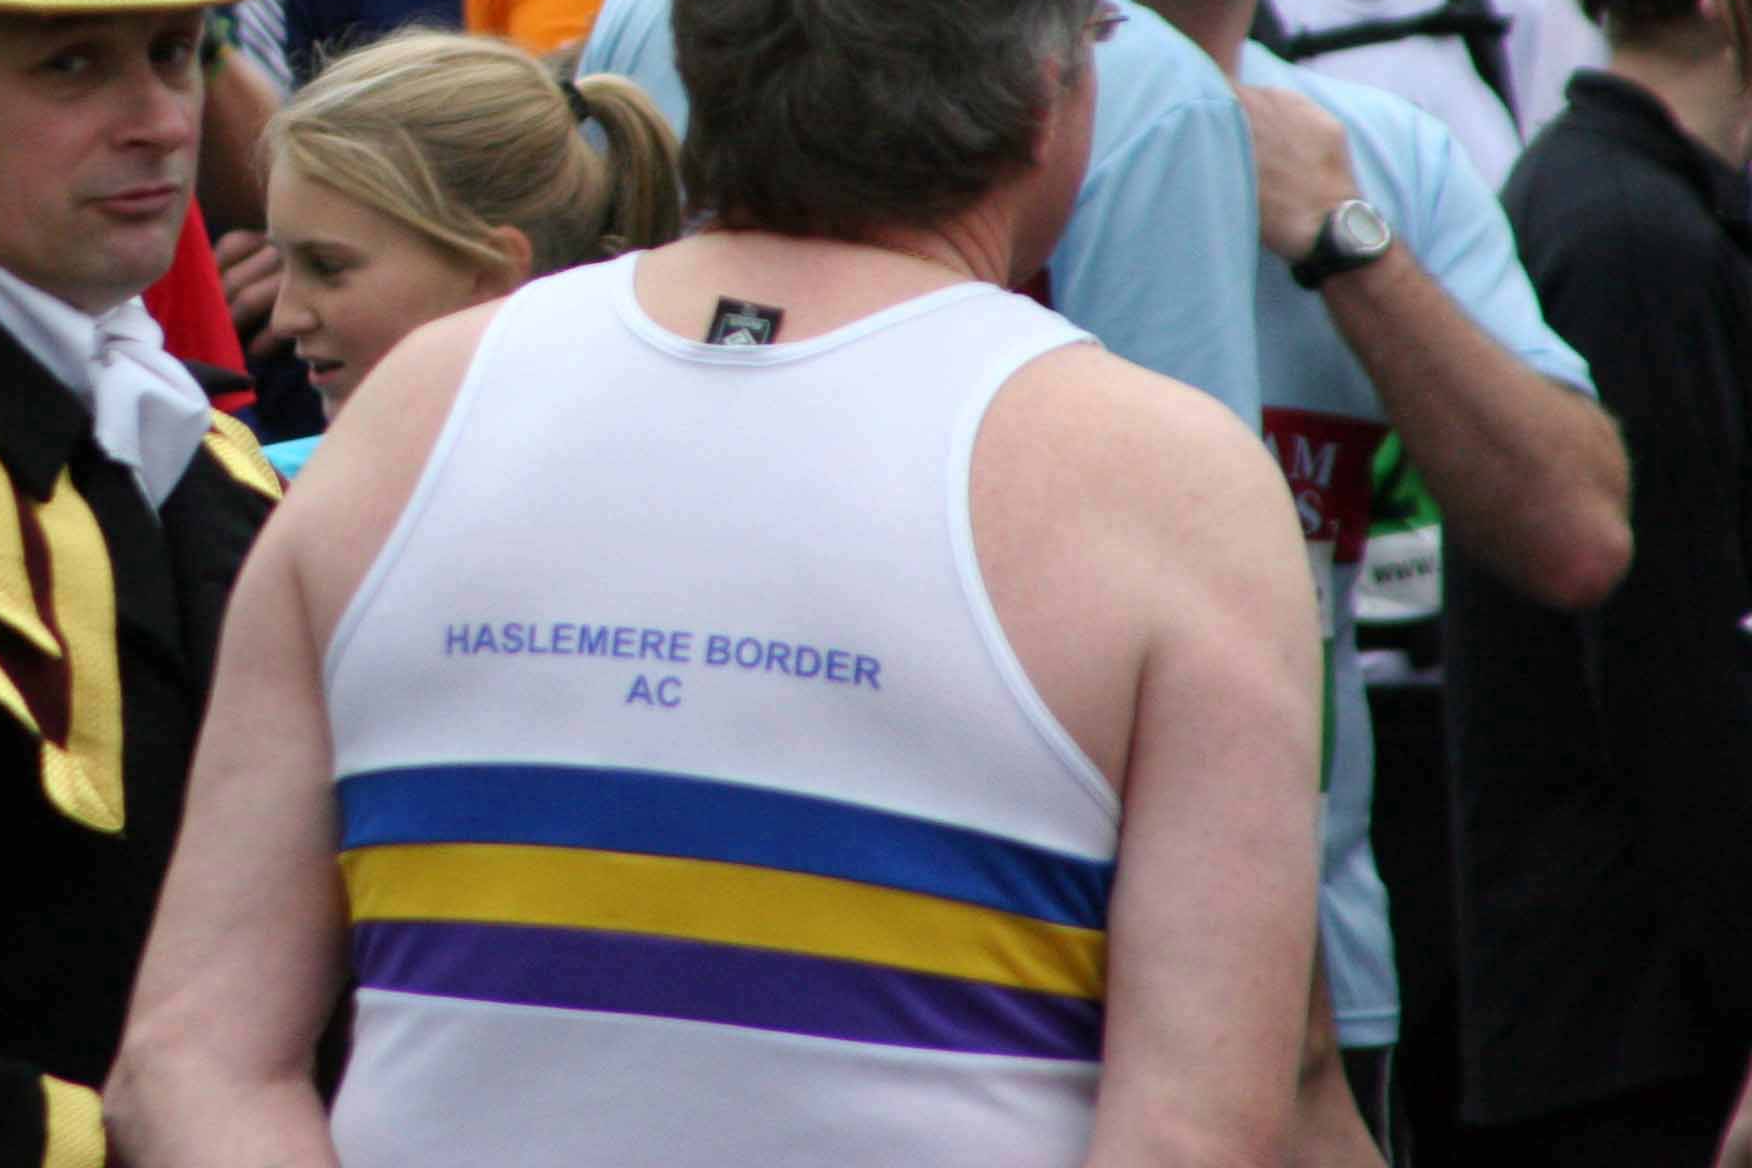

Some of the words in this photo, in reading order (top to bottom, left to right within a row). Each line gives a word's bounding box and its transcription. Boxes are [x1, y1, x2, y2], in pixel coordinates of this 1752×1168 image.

[443, 622, 693, 663] HASLEMERE
[703, 633, 883, 690] BORDER
[625, 674, 684, 709] AC
